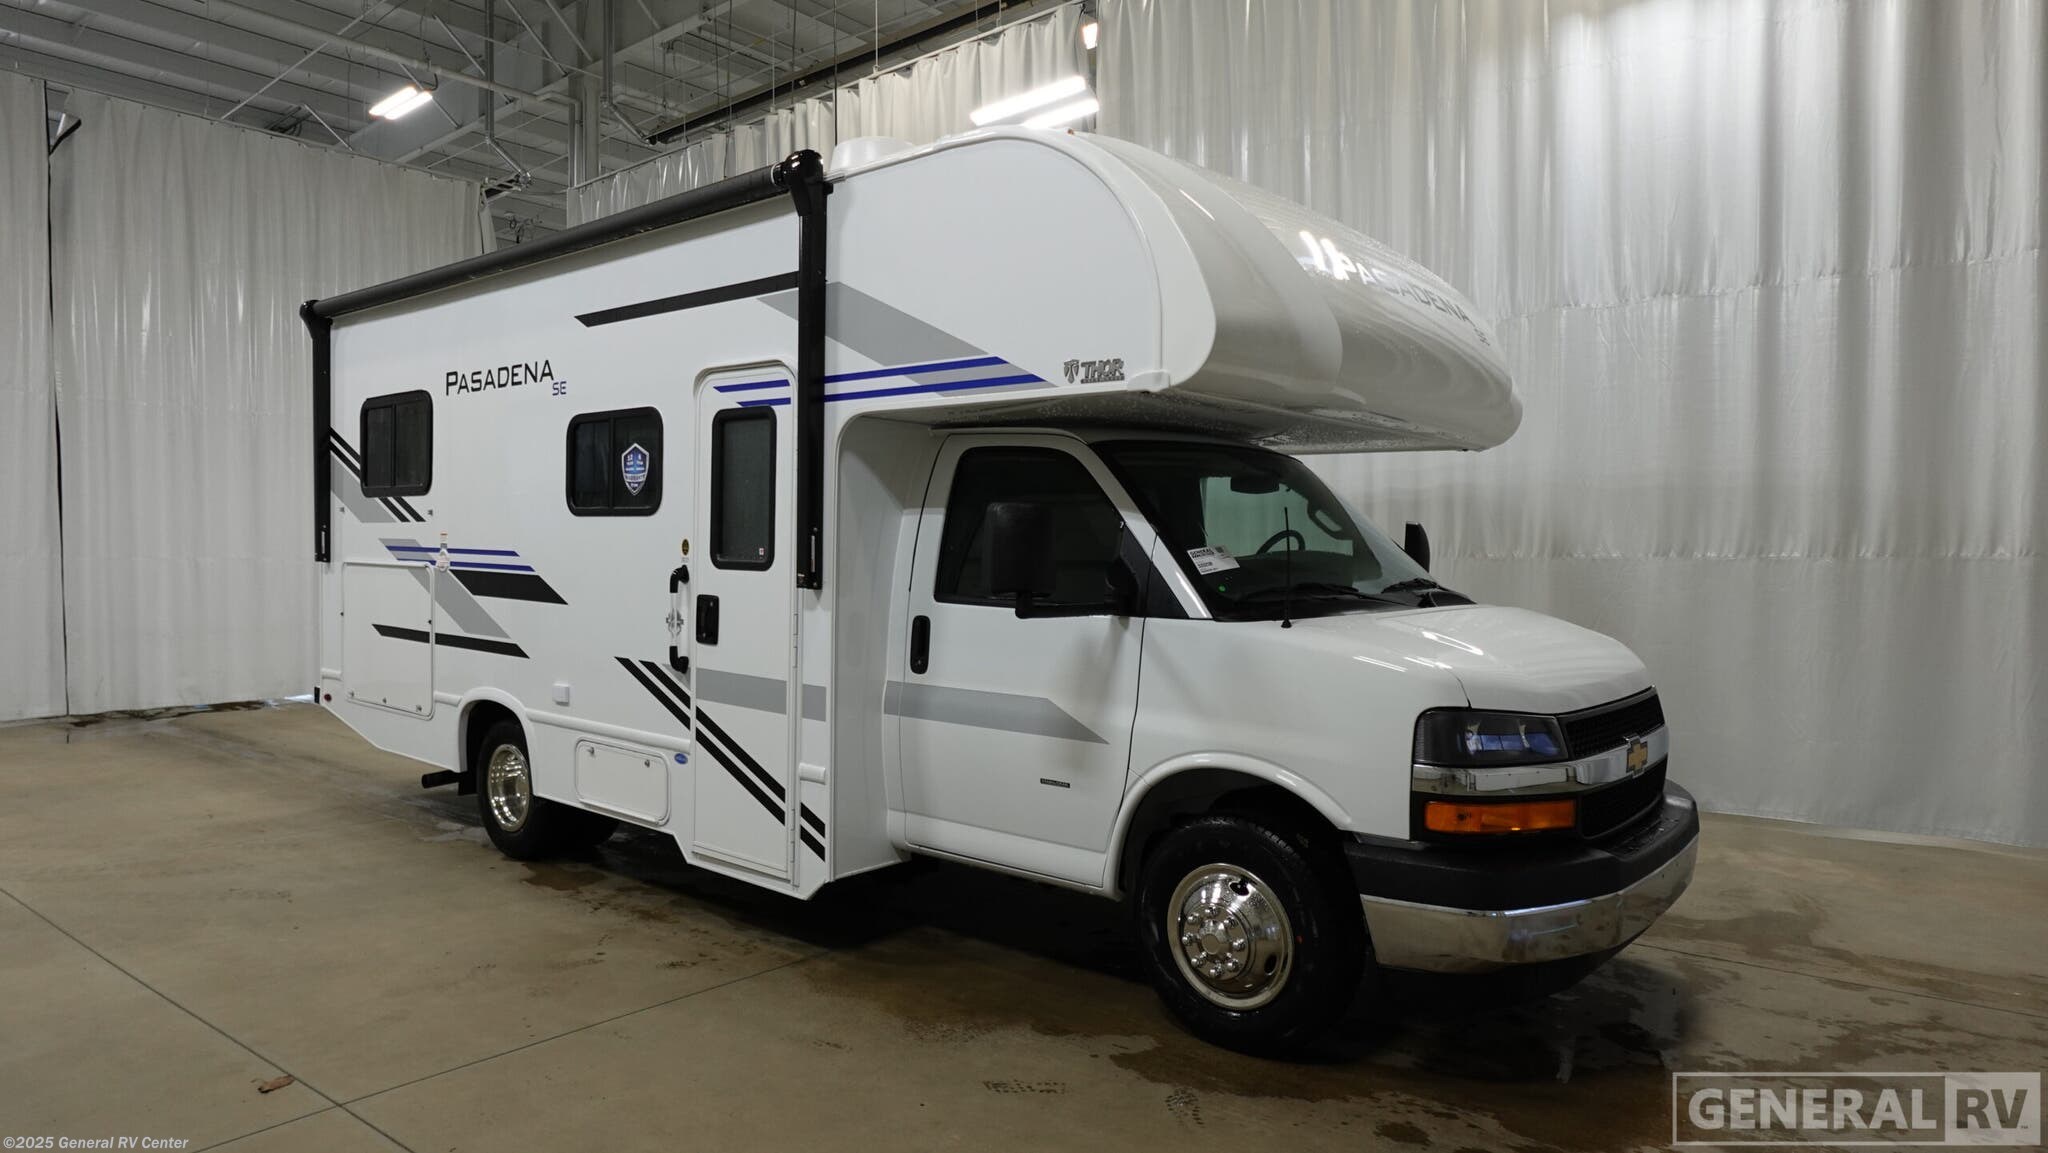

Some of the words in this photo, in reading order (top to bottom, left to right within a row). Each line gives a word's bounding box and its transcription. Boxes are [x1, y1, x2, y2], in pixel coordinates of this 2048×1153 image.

[446, 359, 554, 396] PASADENA
[552, 381, 567, 396] SE
[1081, 358, 1124, 379] THOR
